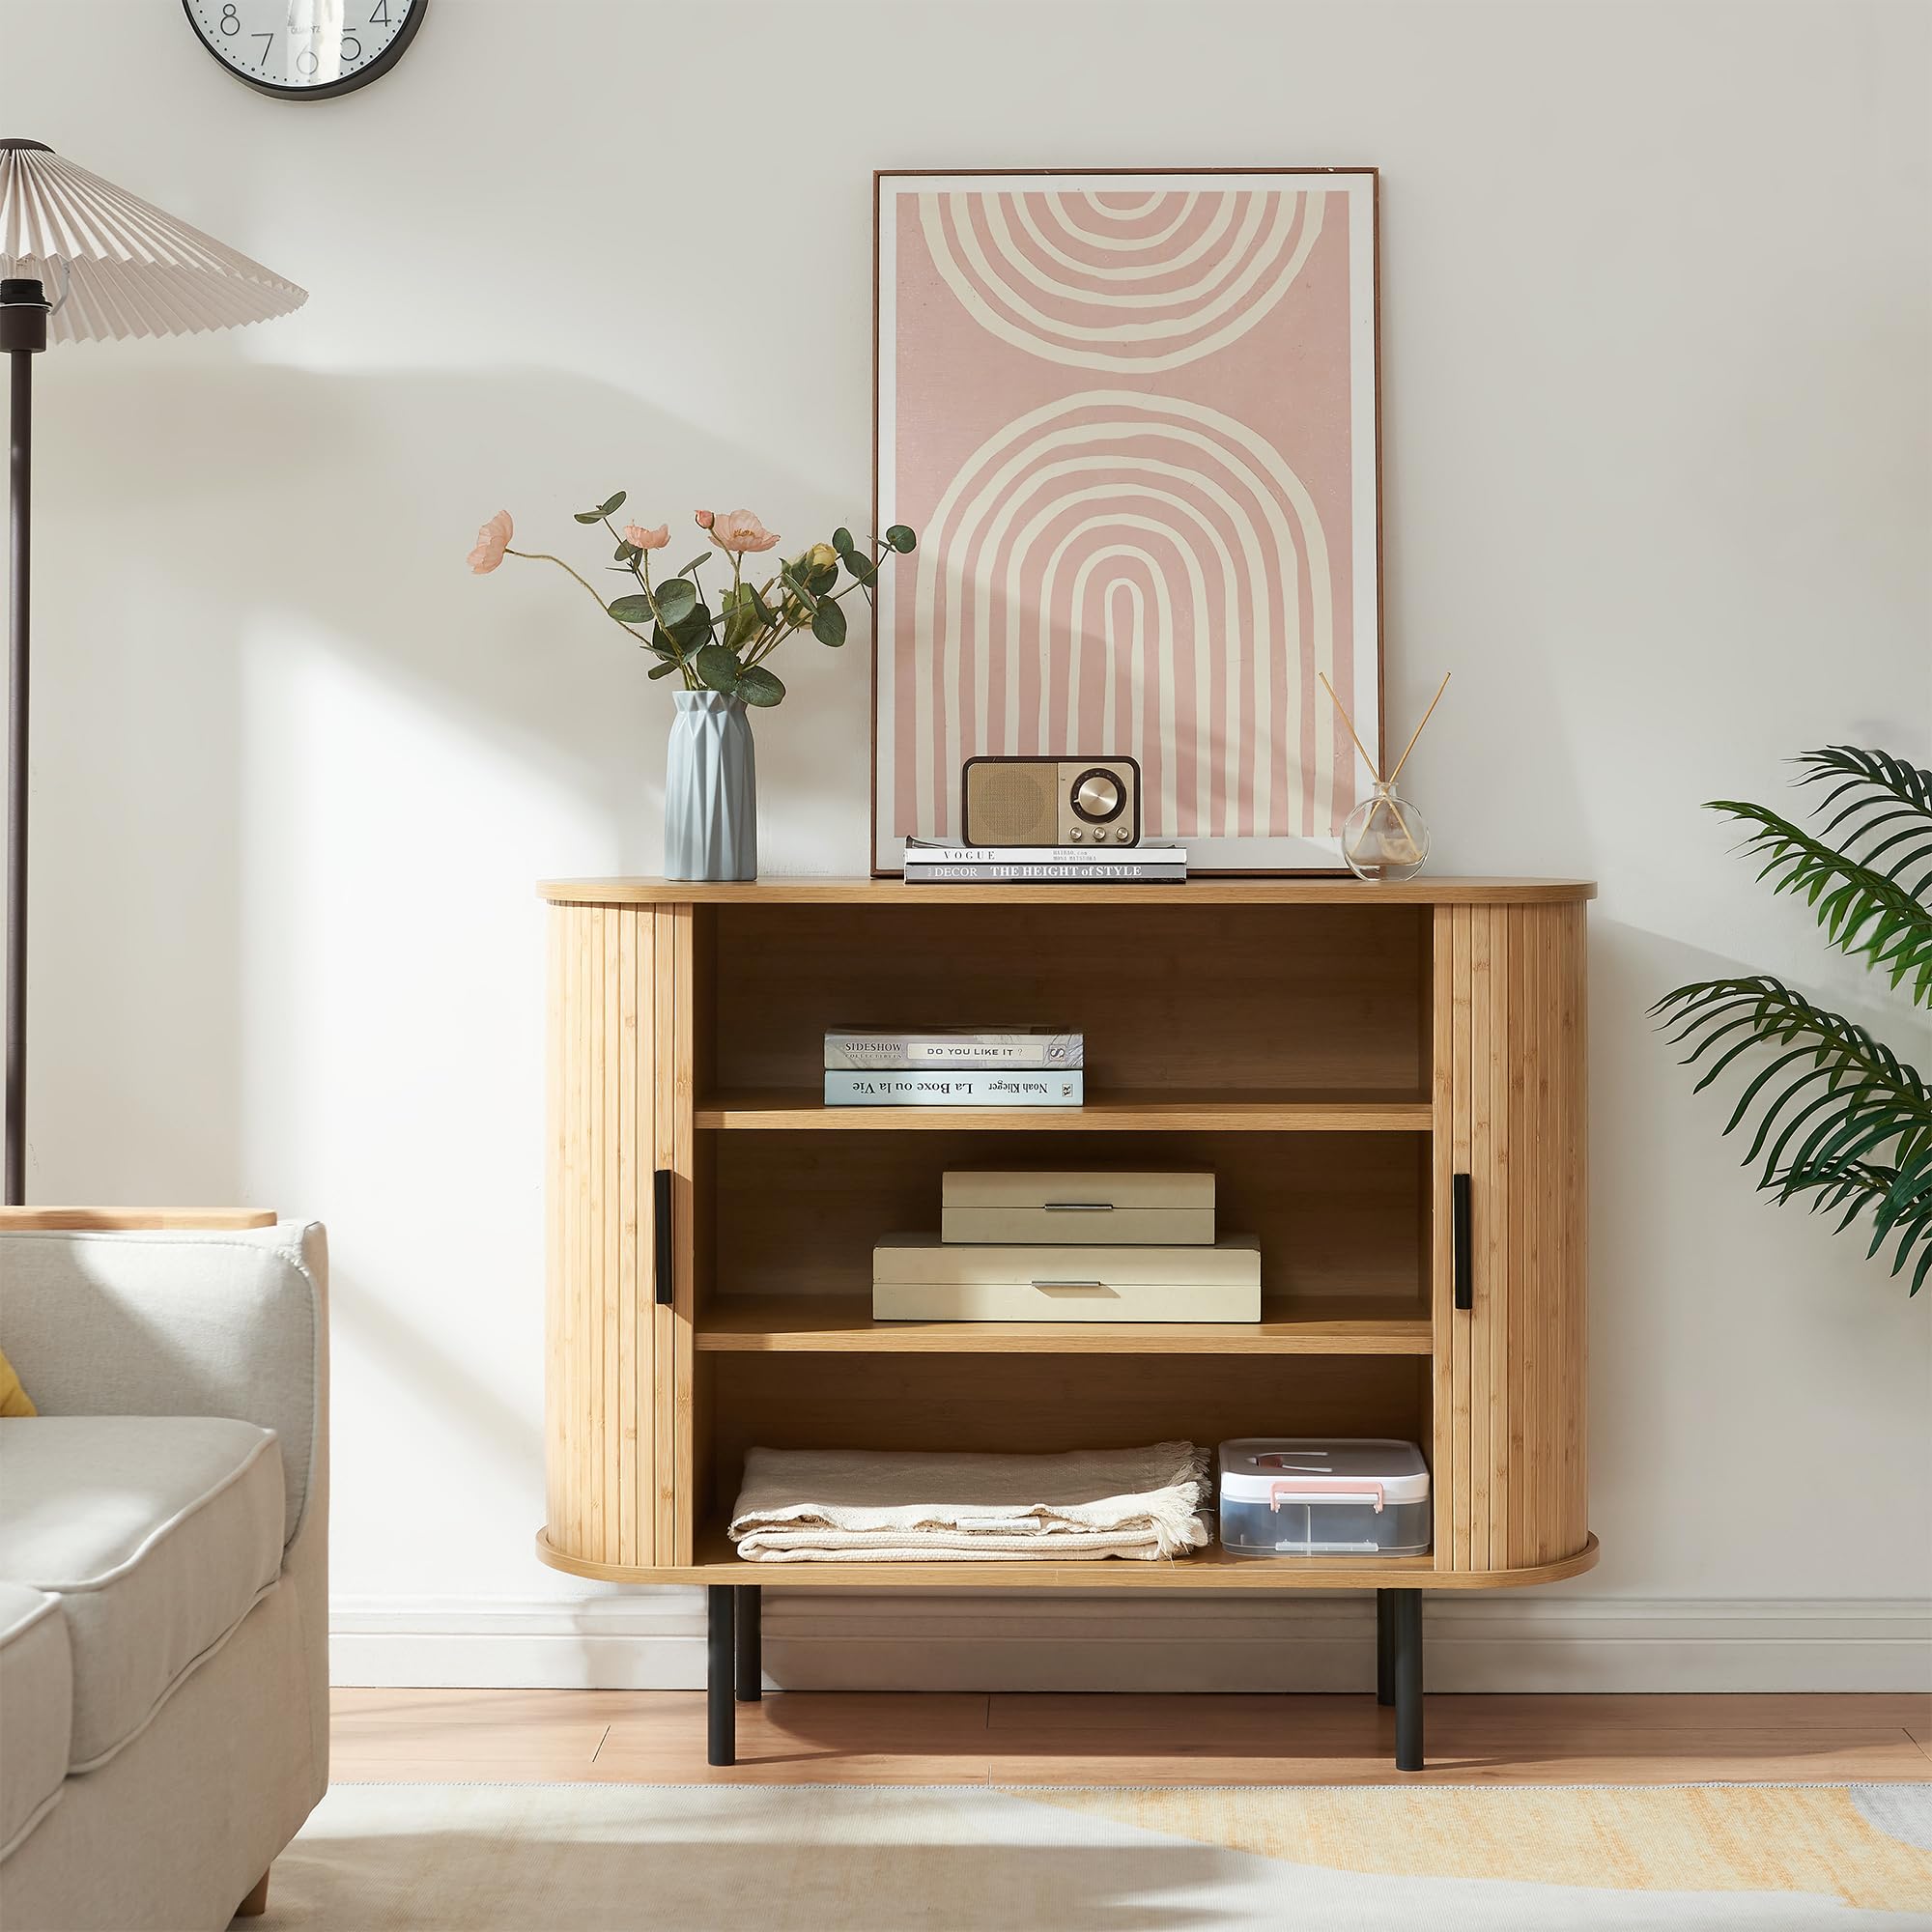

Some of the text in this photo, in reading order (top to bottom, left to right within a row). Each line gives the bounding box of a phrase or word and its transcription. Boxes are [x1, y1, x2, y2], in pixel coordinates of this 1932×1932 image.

[220, 4, 241, 36] 8
[368, 0, 392, 27] 4
[251, 33, 274, 66] 7
[340, 29, 362, 61] 5
[297, 45, 319, 75] 6
[944, 851, 995, 860] VOGUE
[934, 867, 979, 877] DECOR
[990, 866, 1142, 877] THE HEIGHT of STYLE
[845, 1042, 902, 1052] SIDESHOW
[852, 1082, 974, 1094] La Boxe ou la Vie
[988, 1079, 1048, 1094] Noah Klieger
